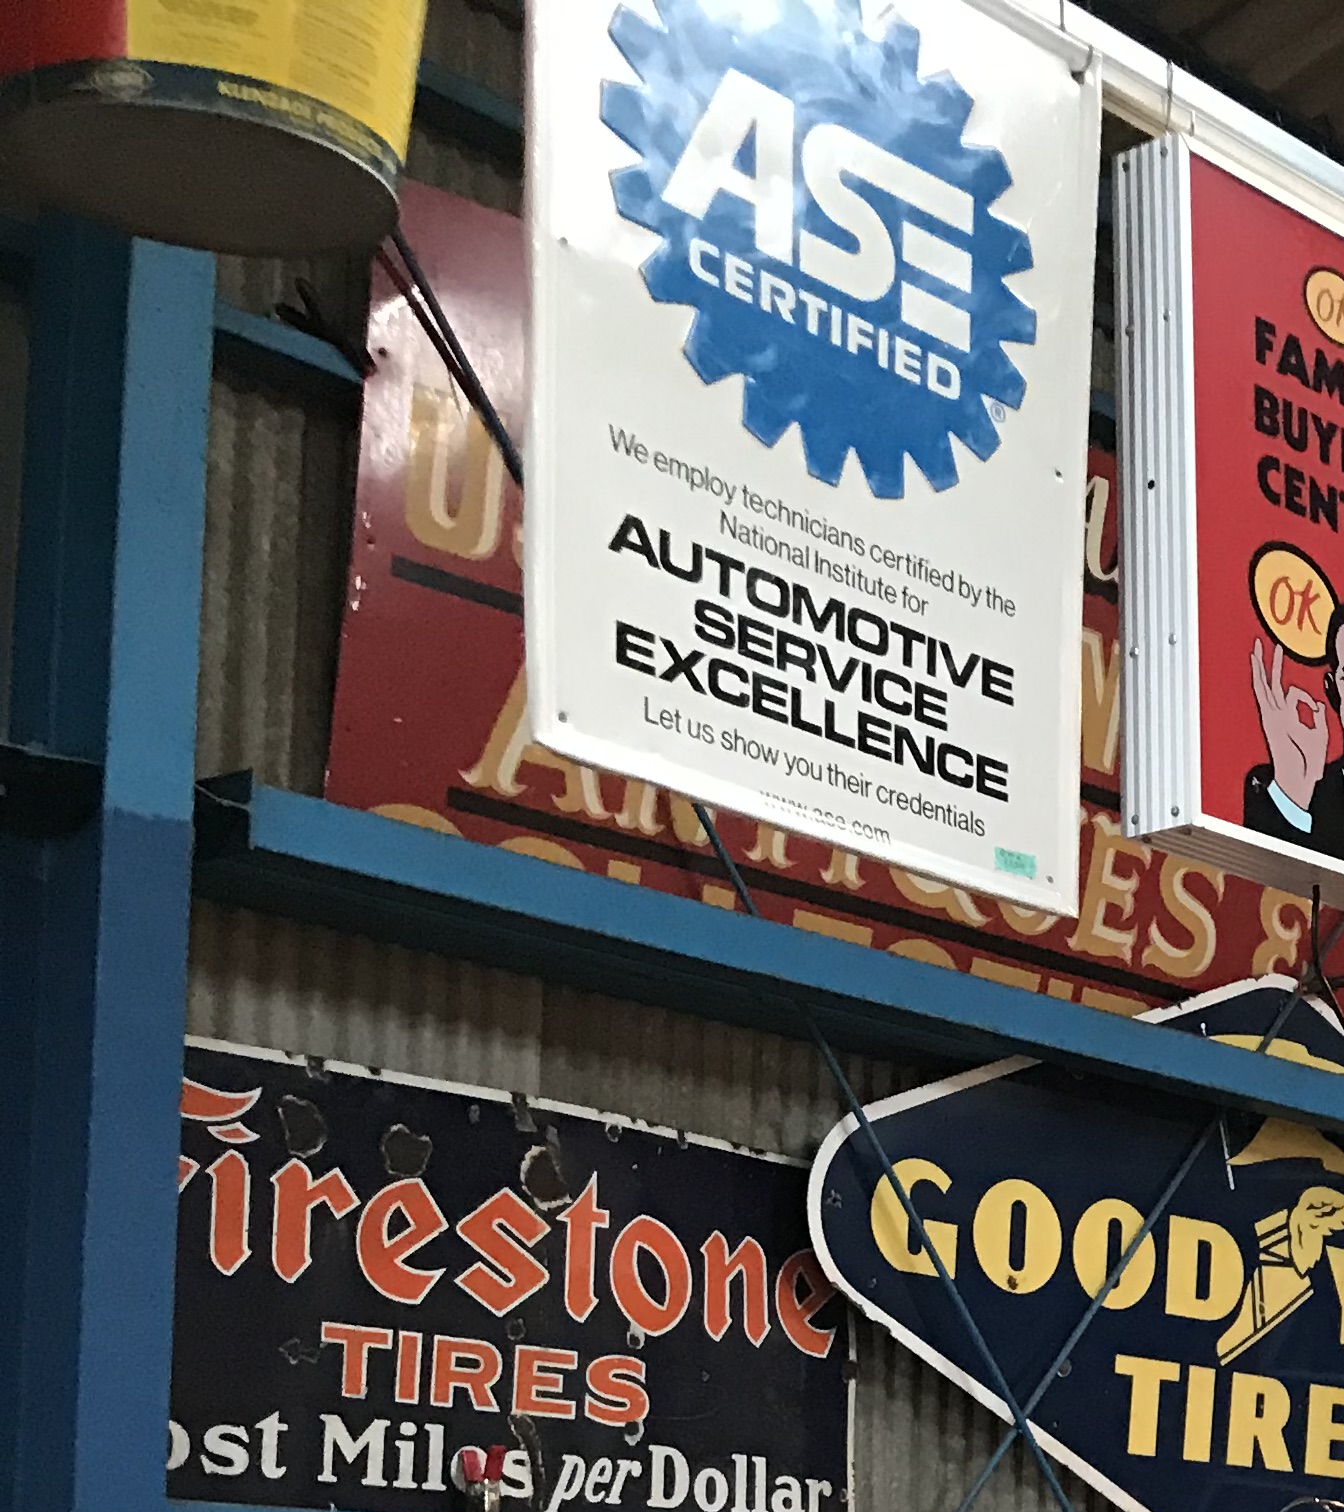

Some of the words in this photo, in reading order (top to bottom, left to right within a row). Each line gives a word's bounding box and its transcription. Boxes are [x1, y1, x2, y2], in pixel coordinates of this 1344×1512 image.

[661, 68, 974, 353] ASE
[688, 236, 961, 400] CERTIFIED
[608, 424, 649, 464] We
[654, 451, 737, 504] employ
[741, 483, 866, 557] technicians
[869, 544, 955, 593] certified
[958, 575, 984, 609] by
[986, 588, 1017, 618] the
[720, 510, 811, 570] National
[813, 551, 898, 604] Institute
[901, 586, 930, 616] for
[608, 513, 1014, 707] AUTOMOTIVE
[694, 600, 949, 732] SERVICE
[1269, 575, 1322, 636] OK
[615, 621, 1009, 802] EXCELLENCE
[644, 697, 682, 735] Let
[687, 718, 715, 744] us
[720, 727, 779, 767] show
[784, 752, 824, 786] you
[827, 763, 873, 801] their
[875, 782, 986, 837] credentials
[870, 1157, 1245, 1322] GOOD
[166, 1411, 289, 1480] ost
[321, 1322, 650, 1428] TIRES
